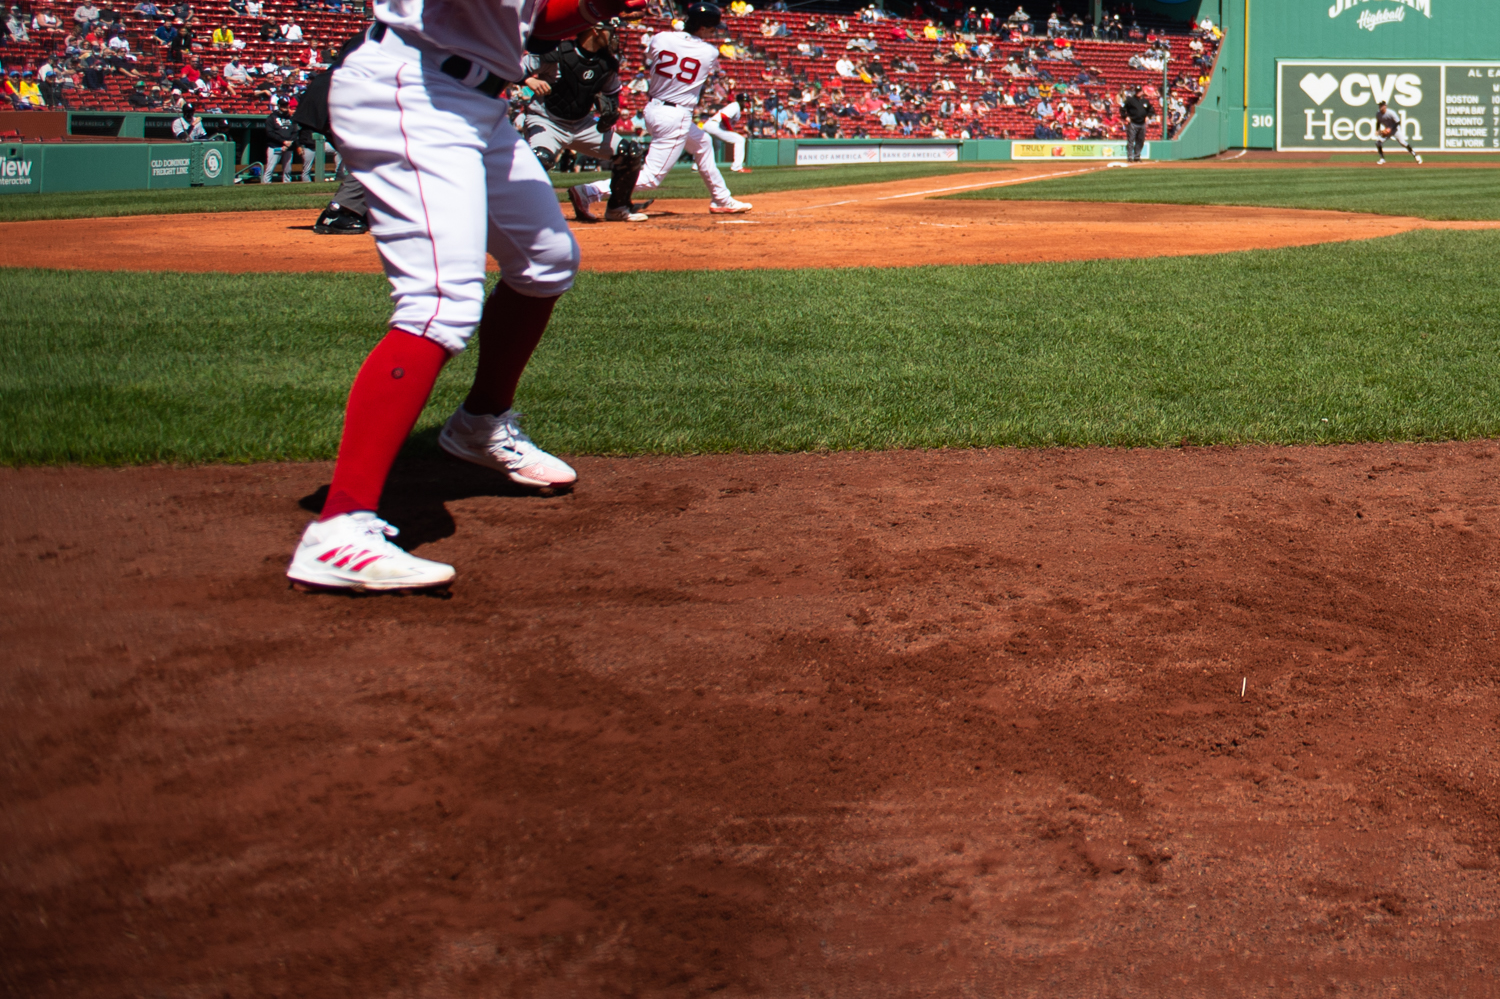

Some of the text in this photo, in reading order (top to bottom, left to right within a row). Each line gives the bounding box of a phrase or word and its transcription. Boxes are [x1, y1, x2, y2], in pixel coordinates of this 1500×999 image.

[1356, 5, 1405, 32] Highball
[655, 50, 701, 85] 29
[1467, 69, 1483, 78] AL
[1340, 72, 1423, 107] CVS
[1492, 83, 1500, 93] W
[1445, 95, 1479, 104] BOSTON
[1491, 95, 1500, 104] 10
[1445, 106, 1486, 115] TAMPA BAY
[1251, 114, 1273, 128] 310
[1304, 108, 1423, 141] Heah
[1445, 117, 1484, 126] TORONTO
[1445, 128, 1488, 137] BALTIMORE
[1021, 144, 1045, 152] TRULY
[1071, 144, 1095, 152] TRULY
[1445, 139, 1463, 148] NEW
[1463, 139, 1485, 148] YORK
[832, 153, 862, 161] AMERICA
[912, 151, 941, 159] AMERICA
[151, 158, 190, 168] OLD DOMINION
[152, 166, 188, 176] FREIGHT LINE
